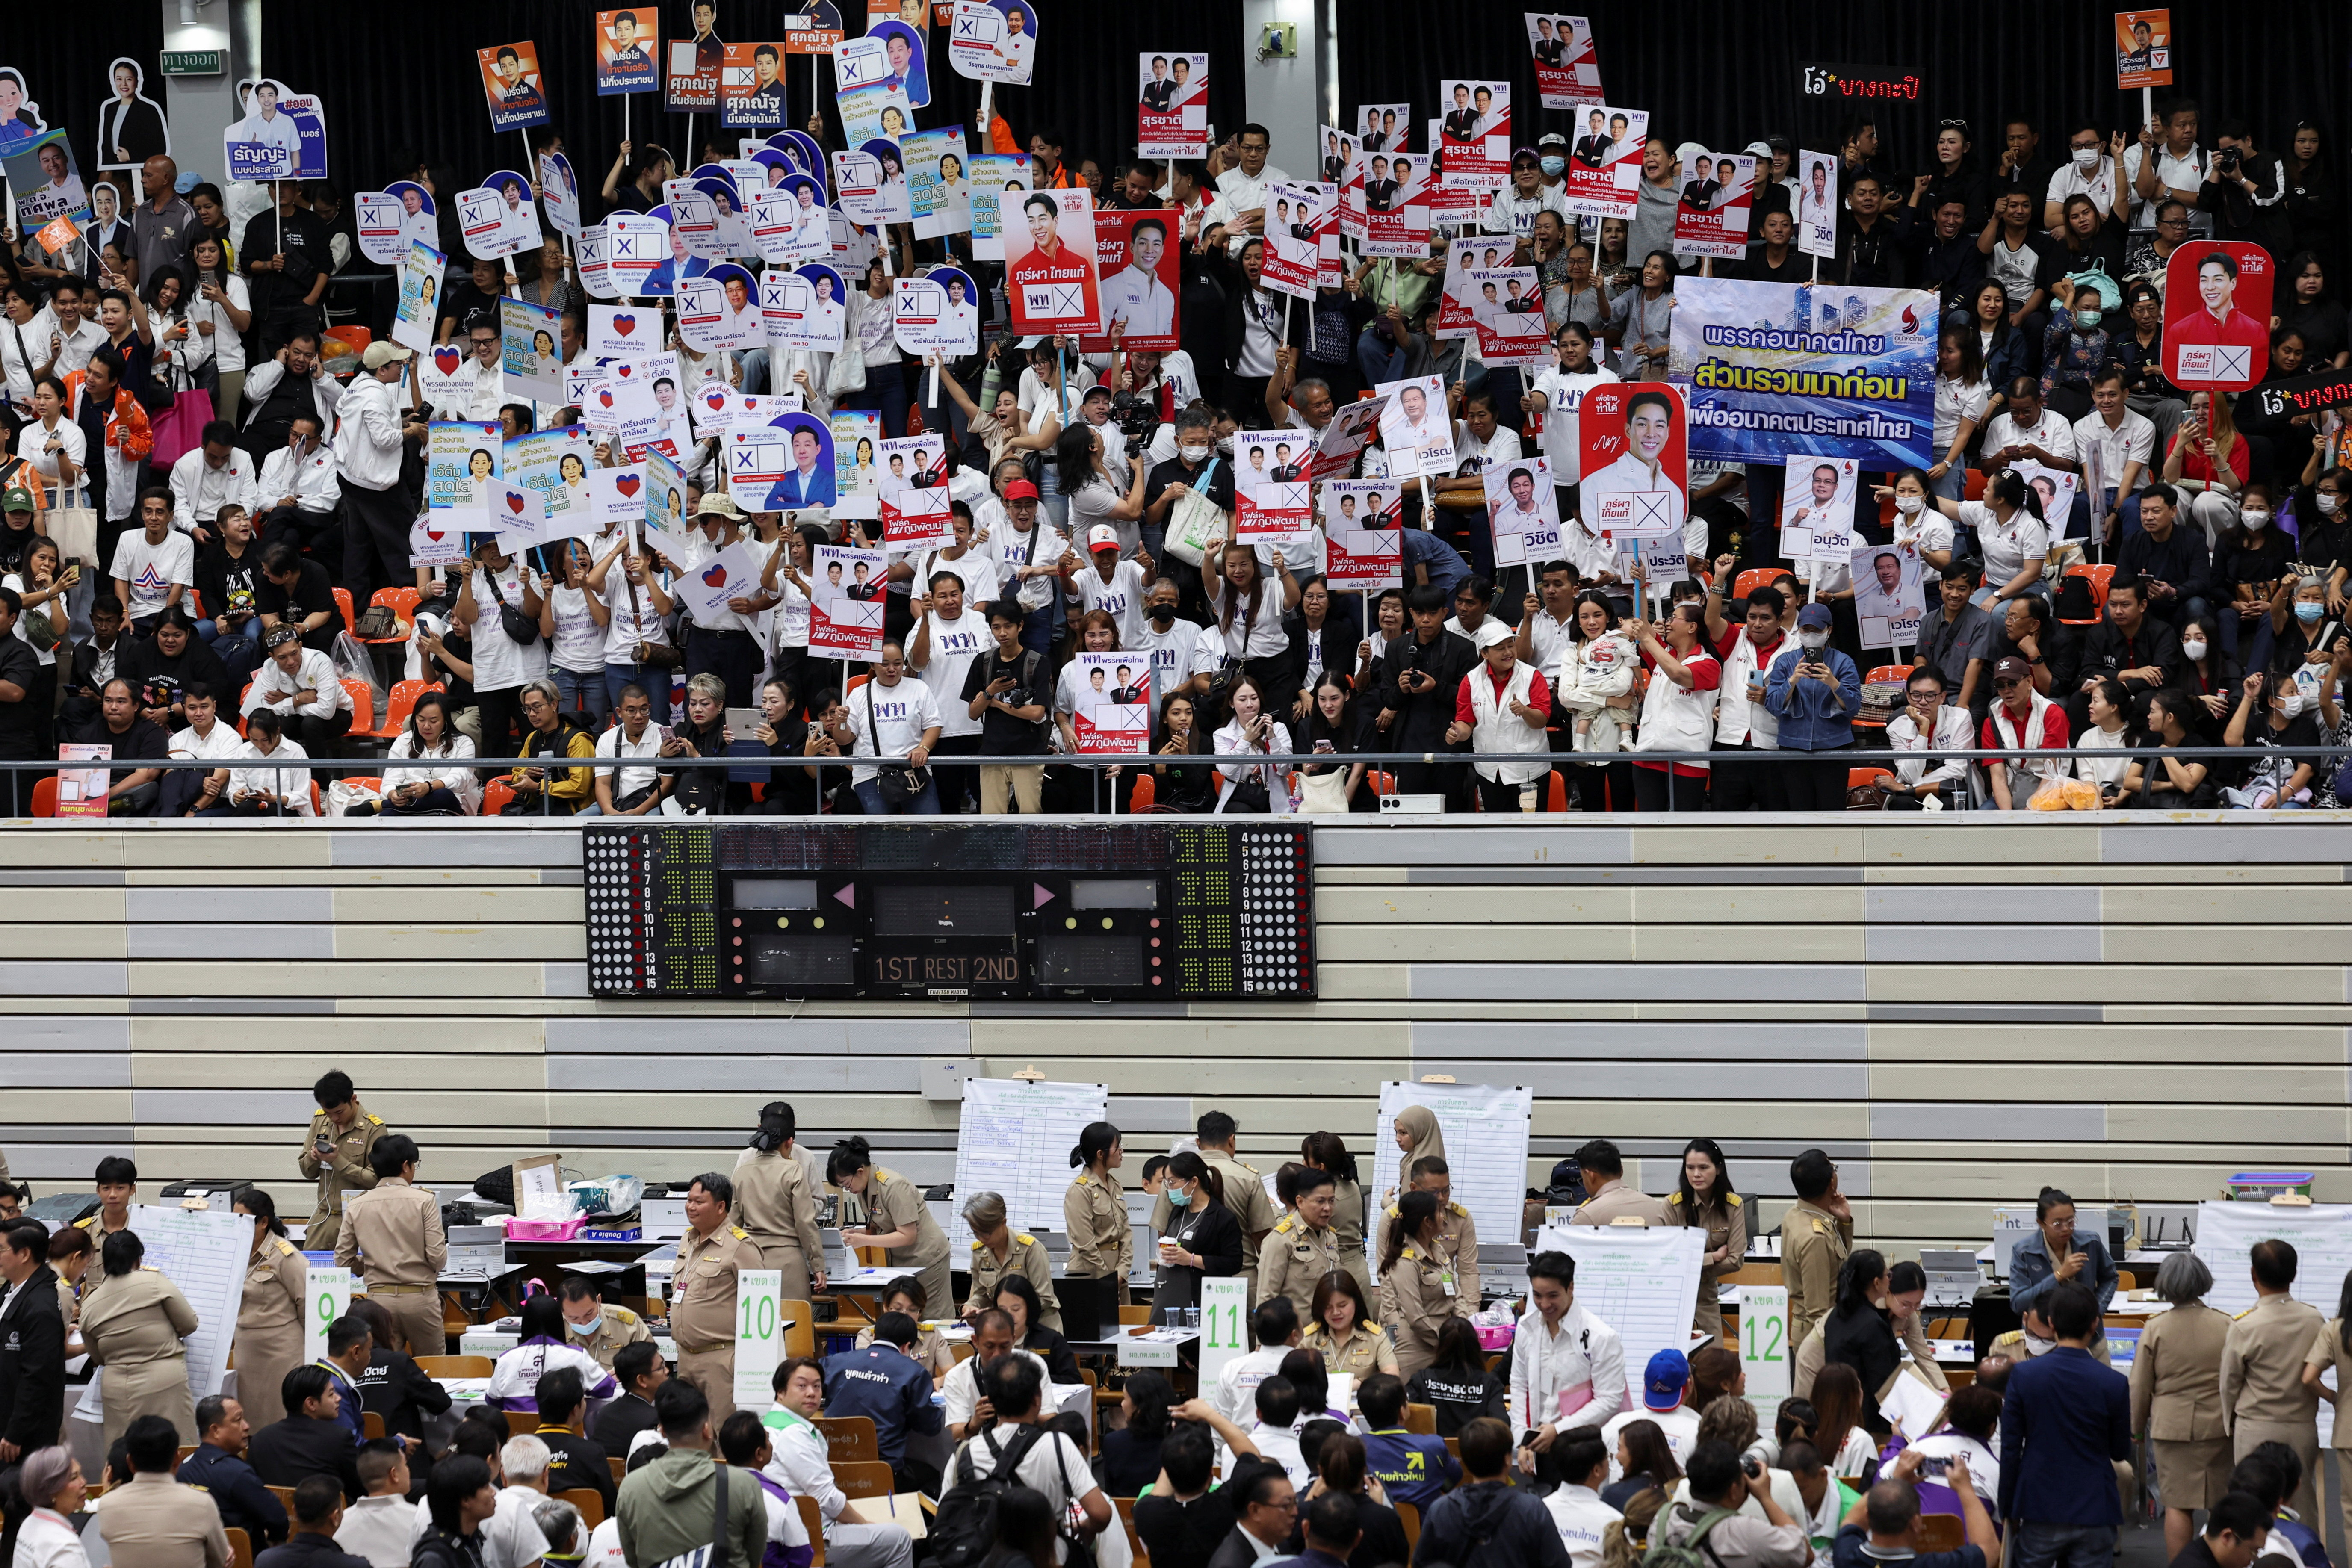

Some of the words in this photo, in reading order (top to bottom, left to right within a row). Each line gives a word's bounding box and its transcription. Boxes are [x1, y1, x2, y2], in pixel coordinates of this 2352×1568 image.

[790, 30, 828, 46] ศุภณัฐ
[164, 54, 217, 66] ทางออก
[612, 50, 640, 61] โปร่งใส
[606, 63, 649, 74] ทำงานจริง
[968, 60, 985, 70] วีรยุทธ
[985, 63, 1013, 71] ประกอบการ
[2120, 64, 2146, 72] ใจสำราญ
[600, 74, 653, 88] ไม่ทิ้งประชาชน
[670, 74, 718, 94] ศุภณัฐ
[1805, 66, 1827, 94] โอ๋
[1839, 75, 1919, 99] บางกะปิ
[284, 98, 312, 110] #ออม
[670, 93, 715, 106] มีนชัยนันท์
[726, 93, 780, 113] ศุภณัฐ
[293, 108, 320, 118] พร้อมเปลี่ยน
[727, 111, 780, 124] มีนชัยนันท์
[1142, 114, 1182, 127] สุรชาติ
[301, 128, 320, 138] เบอร์
[234, 145, 286, 165] ธัญญะ
[1146, 144, 1202, 155] เพื่อไทยทำได้
[1444, 143, 1485, 157] สุรชาติ
[233, 163, 282, 175] เมษประสาท
[1572, 168, 1614, 182] สุรชาติ
[909, 174, 934, 188] เจ๊ติ๋ม
[1451, 175, 1506, 186] เพื่อไทยทำได้
[913, 184, 945, 201] สดใส
[17, 193, 50, 207] พ.ต.อ.
[1064, 201, 1083, 211] ทำได้
[20, 198, 69, 217] ทศพล
[1573, 201, 1630, 216] เพื่อไทยทำได้
[1680, 213, 1723, 225] สุรชาติ
[768, 245, 789, 254] เกรียงไกร
[807, 241, 822, 250] (แพท)
[1682, 243, 1740, 255] เพื่อไทยทำได้
[2241, 260, 2266, 272] ทำได้
[1015, 269, 1047, 283] ภูร์ผา
[1050, 265, 1085, 278] ไทยแท้
[1028, 294, 1049, 306] พท
[724, 332, 745, 340] นะวิโรจน์
[1704, 327, 1885, 356] พรรคอนาคตไทย
[505, 335, 527, 351] เจ๊ติ๋ม
[602, 339, 645, 347] พรรคปวงชนไทย
[505, 348, 536, 366] สดใส
[648, 356, 674, 368] ชัดเจน
[2186, 351, 2211, 361] ภูร์ผา
[2181, 360, 2209, 369] ไทยแท้
[651, 368, 670, 379] ตั้งใจ
[1696, 359, 1906, 399] ส่วนรวมมาก่อน
[2261, 388, 2284, 416] โอ๋
[620, 416, 656, 430] เกรียงไกร
[1689, 401, 1911, 439] เพื่ออนาคตประเทศไทย
[622, 427, 648, 438] สาลีผล
[880, 441, 898, 451] พท
[899, 439, 938, 449] พรรคเพื่อไทย
[1420, 458, 1442, 467] มาตยศิริ
[1443, 456, 1454, 464] (โจ)
[1332, 481, 1351, 491] พท
[1352, 483, 1395, 491] พรรคเพื่อไทย
[889, 519, 909, 527] โฟล์ค
[904, 521, 942, 534] ภูมิพัฒน์
[1525, 530, 1558, 546] วิชิต
[1814, 534, 1849, 547] อนุวัต
[1333, 558, 1355, 566] โฟล์ค
[1649, 554, 1685, 567] ประวัติ
[1348, 561, 1389, 574] ภูมิพัฒน์
[940, 632, 976, 649] พท
[945, 648, 979, 656] พรรคเพื่อไทย
[1082, 654, 1101, 664] พท
[1102, 656, 1143, 664] พรรคเพื่อไทย
[874, 703, 906, 718] พท
[1081, 732, 1102, 740] โฟล์ค
[1096, 737, 1137, 749] ภูมิพัฒน์
[59, 805, 85, 814] กนกนุช
[643, 835, 649, 845] 4
[1241, 833, 1248, 842] 4
[644, 862, 650, 871] 6
[644, 888, 650, 898] 8
[644, 914, 654, 924] 10
[1241, 941, 1251, 951] 12
[876, 957, 917, 980] 1ST
[925, 958, 967, 980] REST
[973, 957, 1018, 980] 2ND
[646, 979, 656, 989] 15
[1243, 981, 1253, 991] 15
[319, 1273, 337, 1284] เขต
[751, 1275, 768, 1286] เขต
[1215, 1285, 1233, 1294] เขต
[1753, 1295, 1773, 1306] เขต
[318, 1293, 335, 1338] 9
[741, 1295, 775, 1340] 10
[1207, 1303, 1240, 1348] 11
[1745, 1316, 1783, 1361] 12
[844, 1367, 889, 1385] พูดแล้วทำ
